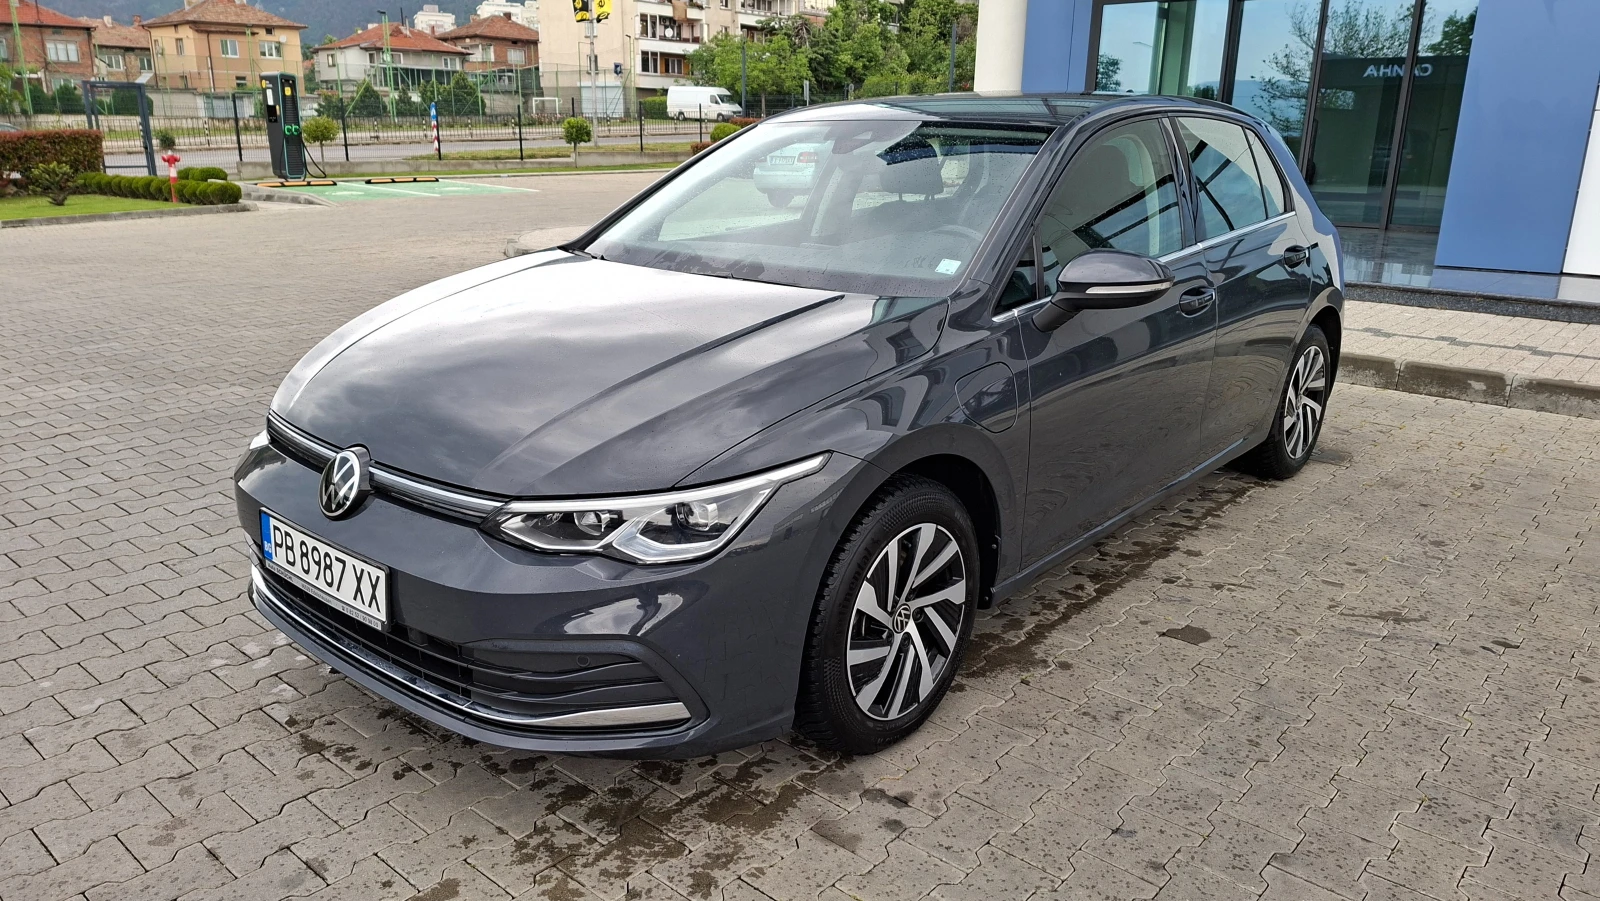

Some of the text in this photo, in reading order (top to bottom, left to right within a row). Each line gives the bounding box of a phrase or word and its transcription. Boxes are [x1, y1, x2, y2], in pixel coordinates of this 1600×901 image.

[264, 540, 272, 553] BG
[272, 524, 381, 613] PB 8987 XX
